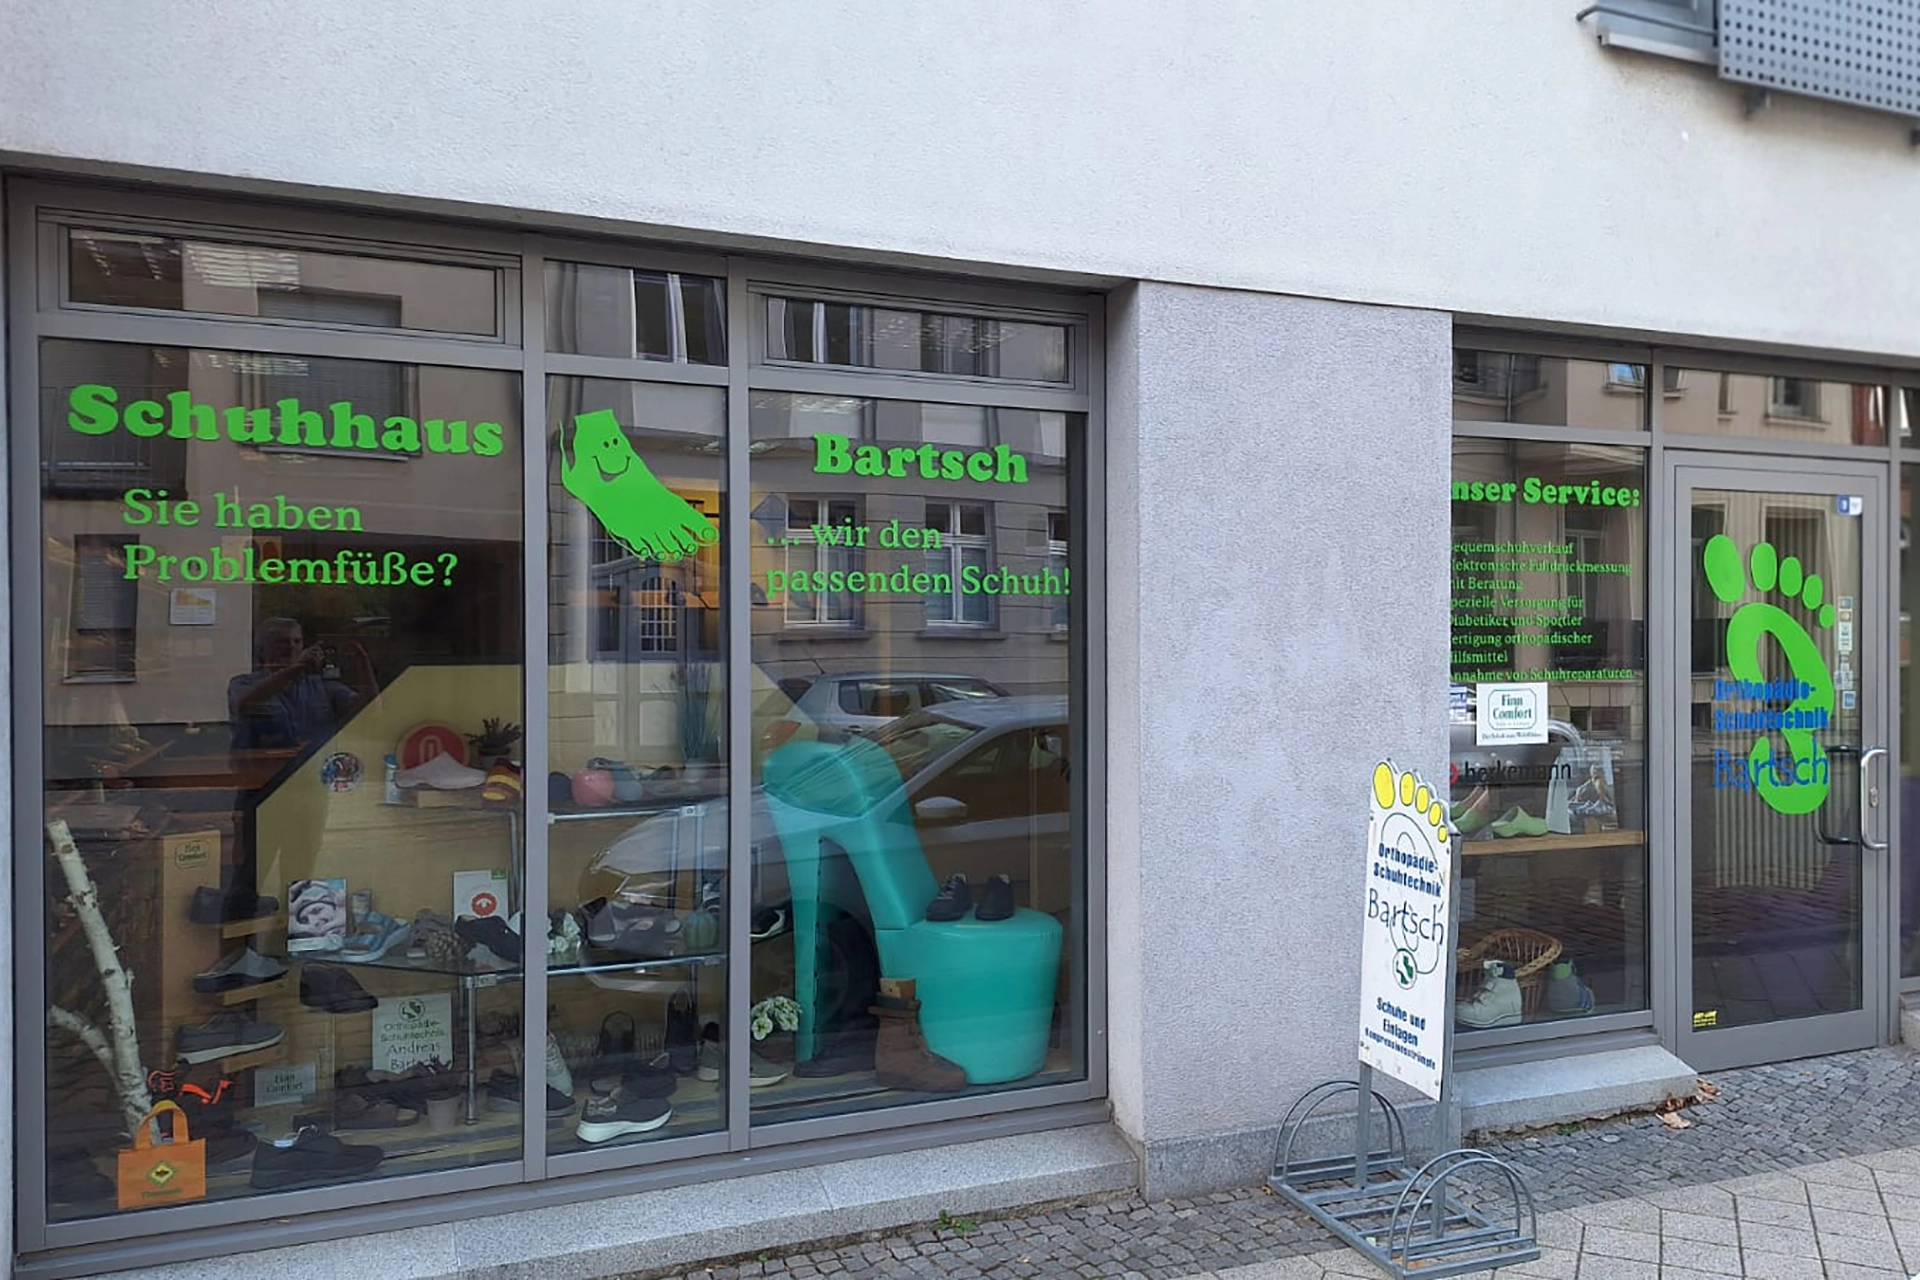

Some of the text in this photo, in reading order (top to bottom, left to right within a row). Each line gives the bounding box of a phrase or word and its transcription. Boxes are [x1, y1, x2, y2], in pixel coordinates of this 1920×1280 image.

[67, 384, 504, 456] Schuhhaus
[813, 432, 1029, 483] Bartsch
[1451, 477, 1641, 507] nser Service:
[122, 488, 363, 531] Sie haben
[811, 517, 870, 548] wir
[880, 519, 942, 549] den
[1451, 541, 1574, 555] equemschuhverkauf
[123, 543, 458, 587] Problemfüße?
[1452, 558, 1526, 571] lektronische
[766, 564, 1071, 598] passenden Schuh!
[1468, 576, 1523, 592] Beratung
[1451, 595, 1496, 610] pezielle
[1567, 596, 1585, 608] für
[1510, 613, 1533, 627] und
[1536, 613, 1583, 629] Sportler
[1451, 632, 1502, 647] ertigung
[1451, 668, 1503, 681] nnahme
[1506, 670, 1528, 681] von
[1493, 706, 1532, 719] Comfort
[1502, 694, 1523, 706] Finn
[1715, 706, 1829, 731] Schuhtechnik
[1714, 736, 1829, 794] Bartsch
[1373, 862, 1442, 898] Schuhtechnik
[1368, 888, 1444, 945] Bartsch
[1376, 996, 1426, 1031] Schuhe und
[1383, 1018, 1419, 1047] Einlagen
